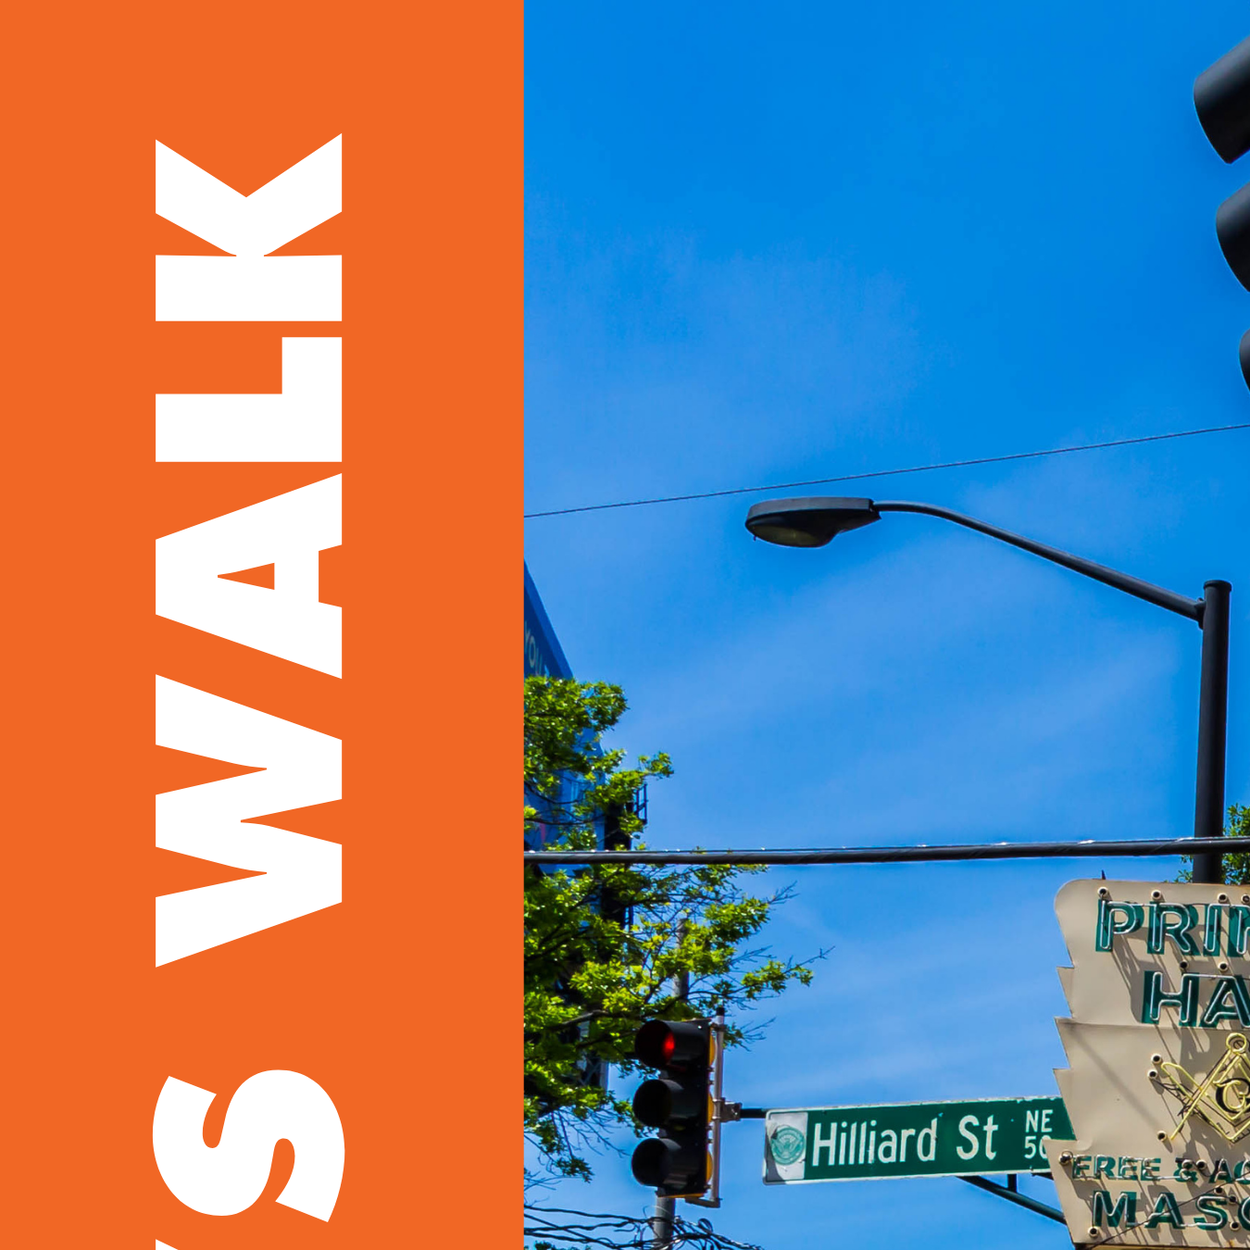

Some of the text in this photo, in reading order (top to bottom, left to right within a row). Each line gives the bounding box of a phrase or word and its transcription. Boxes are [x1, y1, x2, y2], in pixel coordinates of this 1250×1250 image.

[1025, 1109, 1054, 1133] NE
[812, 1116, 939, 1168] Hilliard
[956, 1114, 999, 1161] St
[1072, 1154, 1162, 1182] FREE
[1172, 1157, 1200, 1184] &
